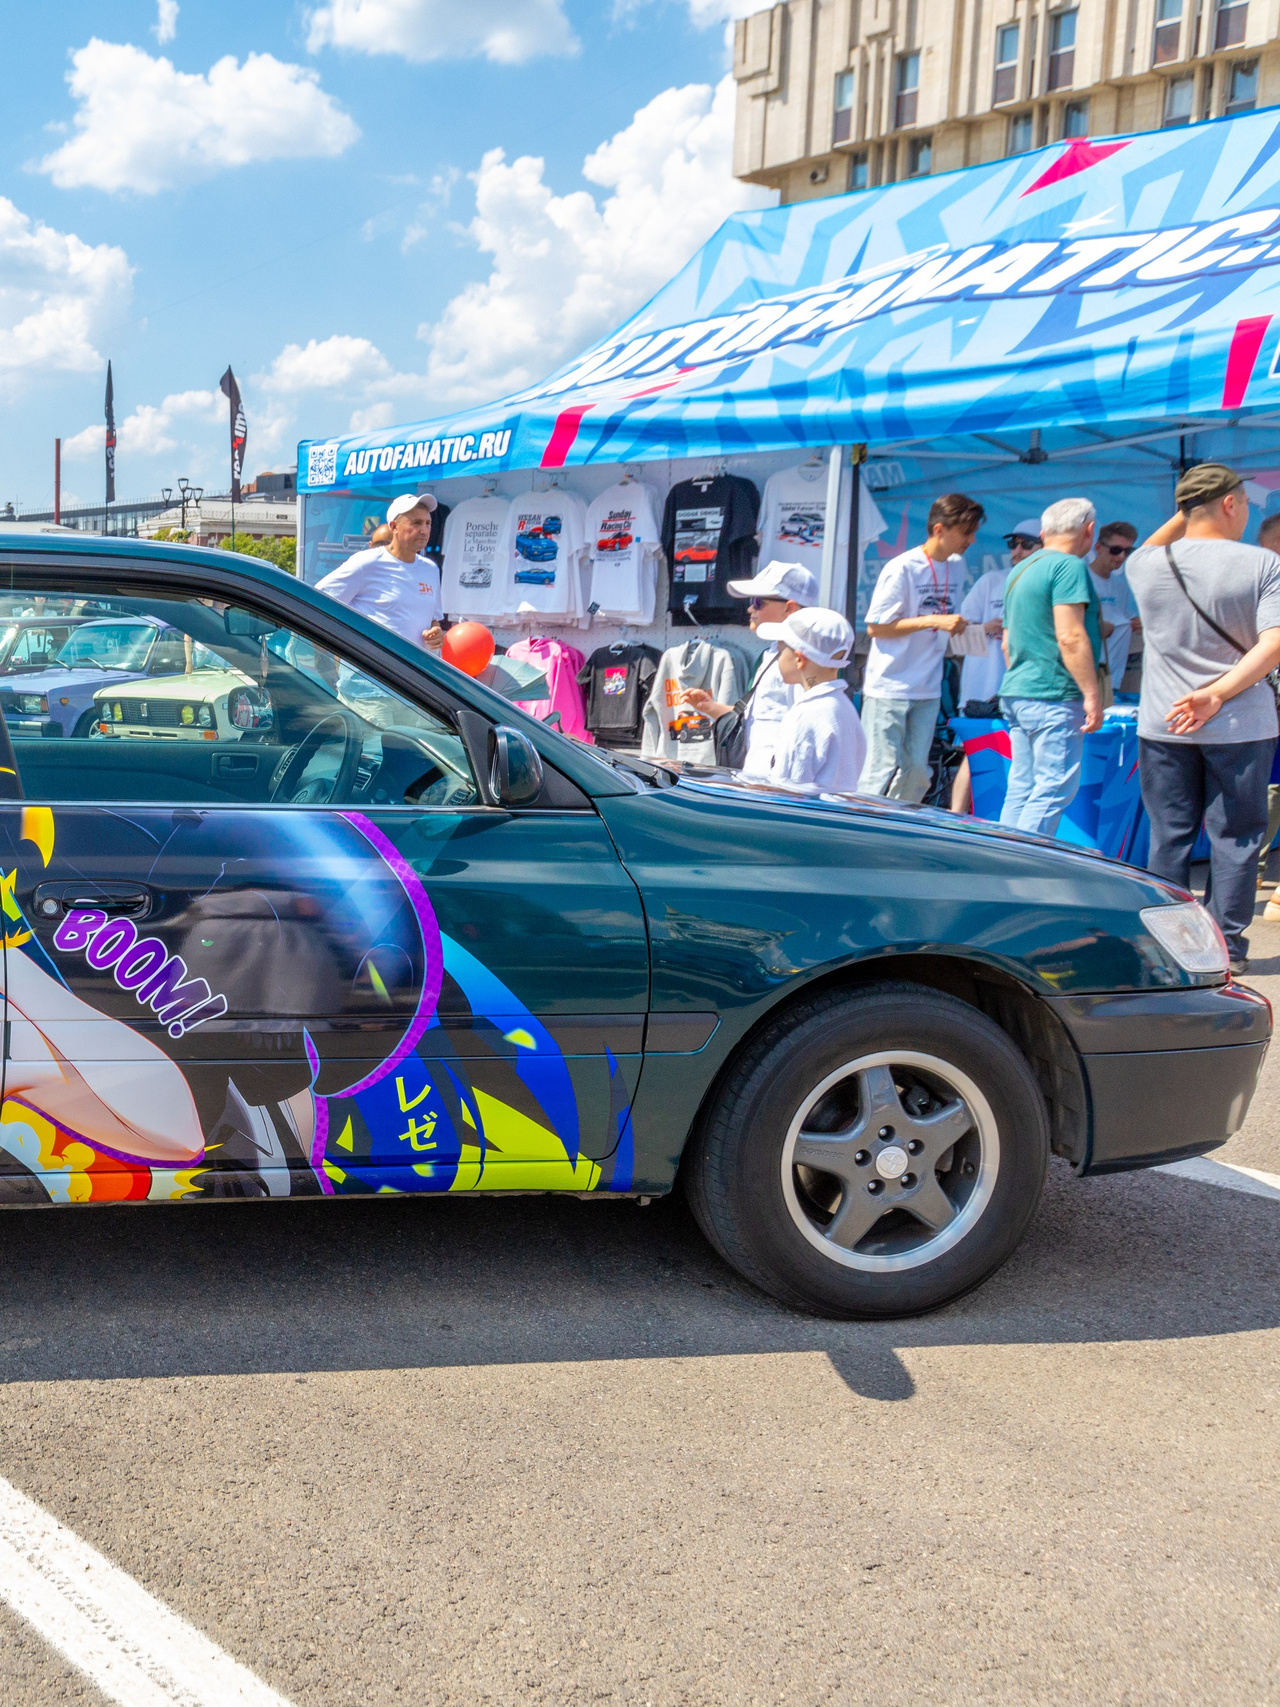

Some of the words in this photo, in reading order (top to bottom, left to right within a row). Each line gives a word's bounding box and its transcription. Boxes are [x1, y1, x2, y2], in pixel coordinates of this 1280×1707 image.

[520, 208, 1280, 401] AUTOFANATIC.
[344, 430, 511, 475] AUTOFANATIC.RU
[600, 521, 623, 531] Racing
[608, 508, 632, 520] Sunday
[53, 909, 228, 1039] BOOM!
[395, 1076, 438, 1152] レゼ
